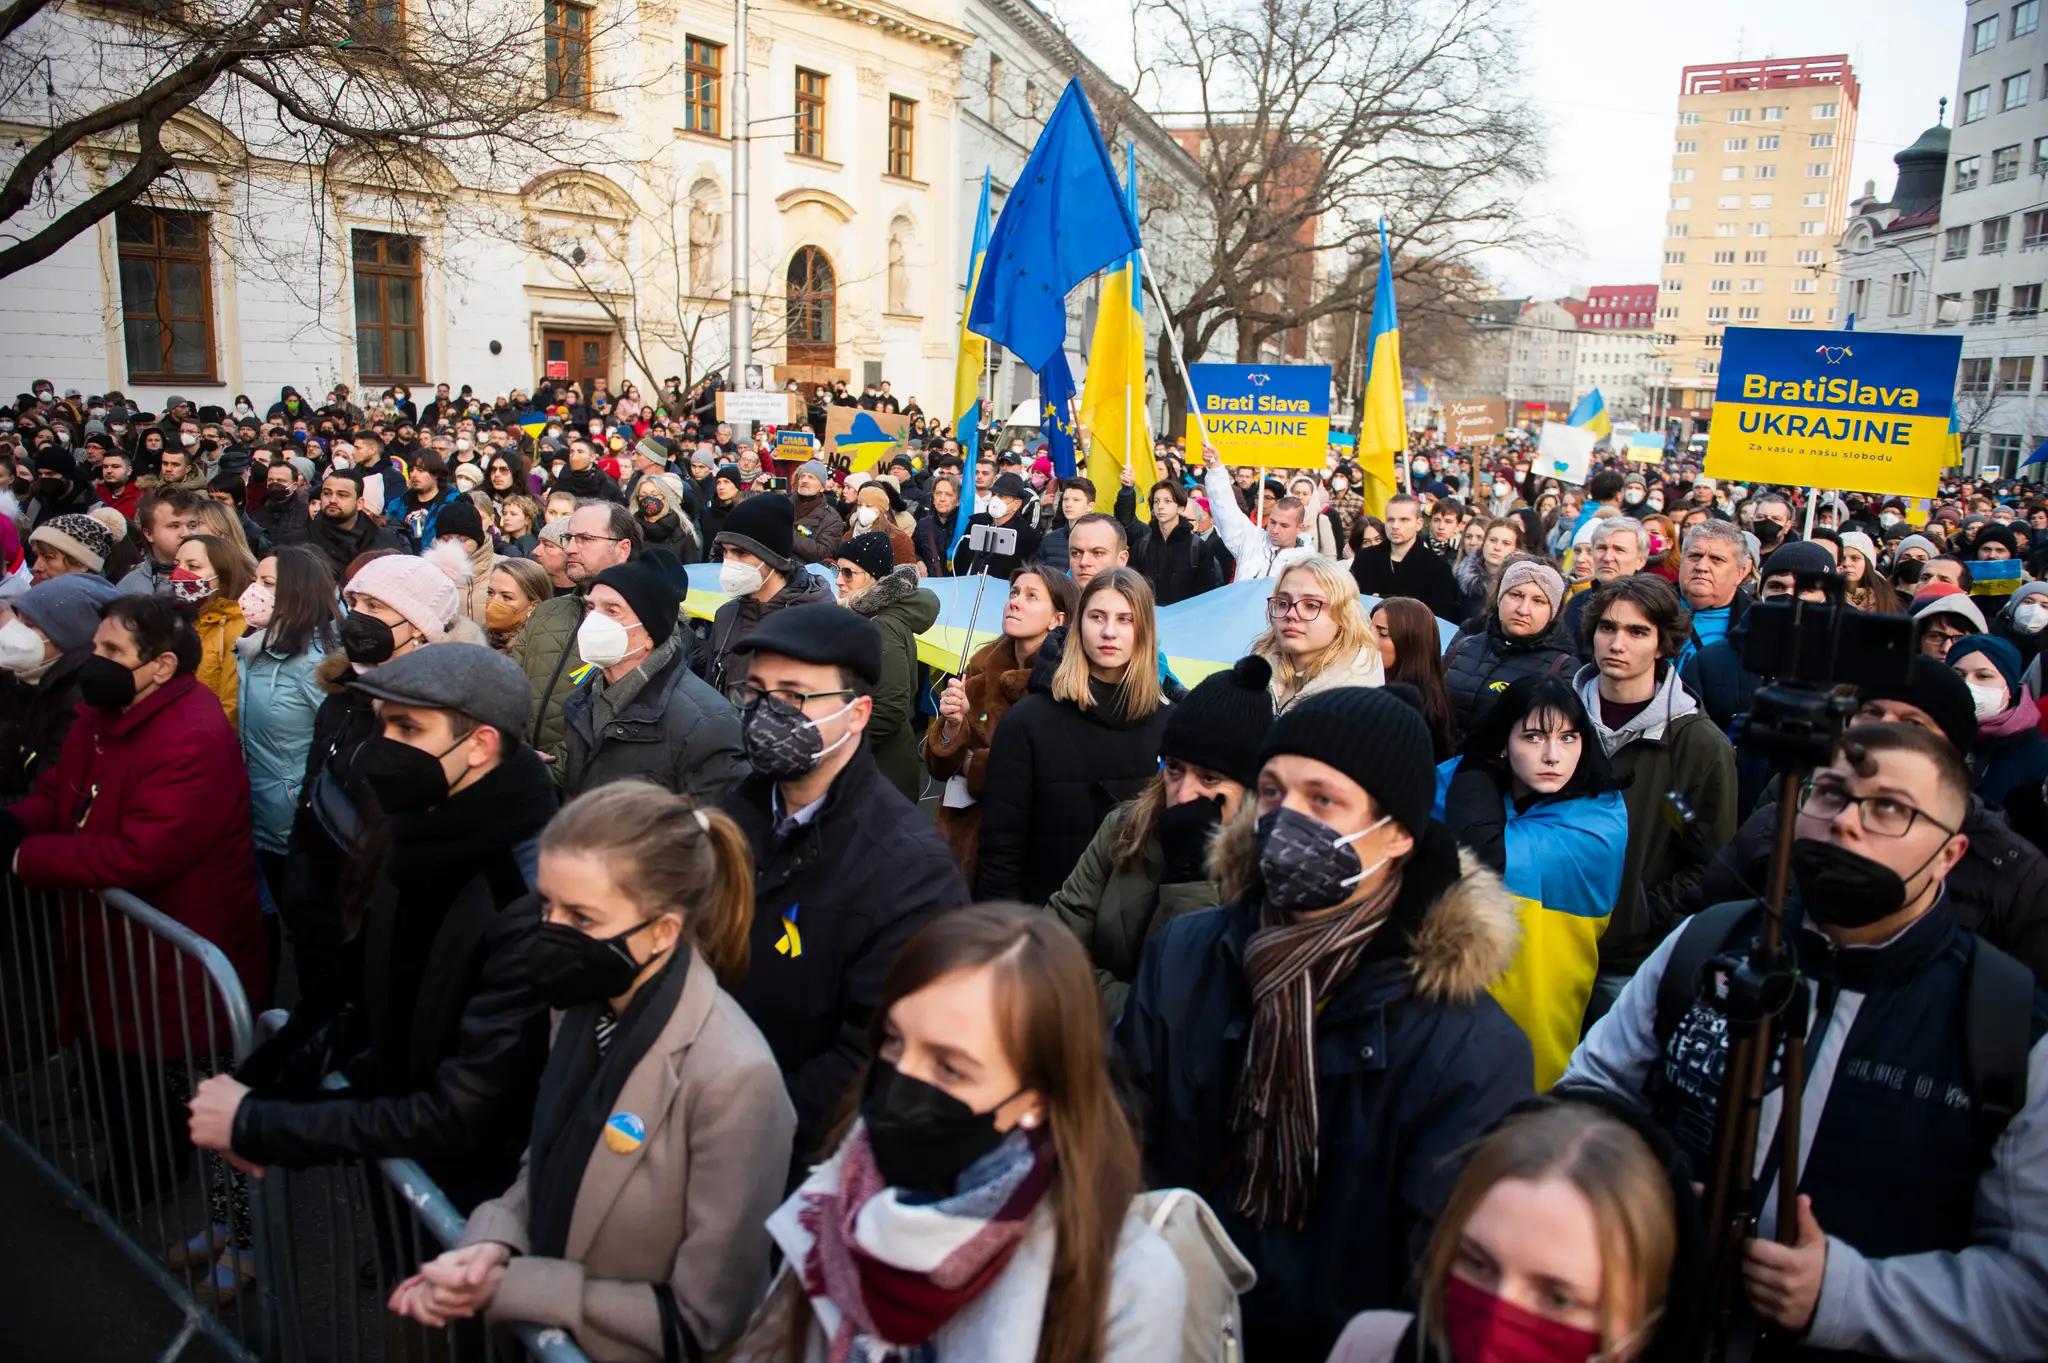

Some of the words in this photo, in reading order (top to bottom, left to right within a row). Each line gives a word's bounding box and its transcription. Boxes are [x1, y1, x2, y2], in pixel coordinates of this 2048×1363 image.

[1742, 373, 1920, 408] BratiSlava
[1206, 393, 1254, 411] Brati
[1258, 395, 1310, 412] Slava
[1207, 419, 1308, 436] UKRAJINE
[1738, 411, 1913, 446] UKRAJINE
[782, 435, 809, 446] СЛАВА
[828, 452, 851, 470] NO
[1749, 443, 1762, 451] Za
[1767, 444, 1793, 454] vašu
[1810, 447, 1838, 457] našu
[1843, 451, 1893, 462] slobodu
